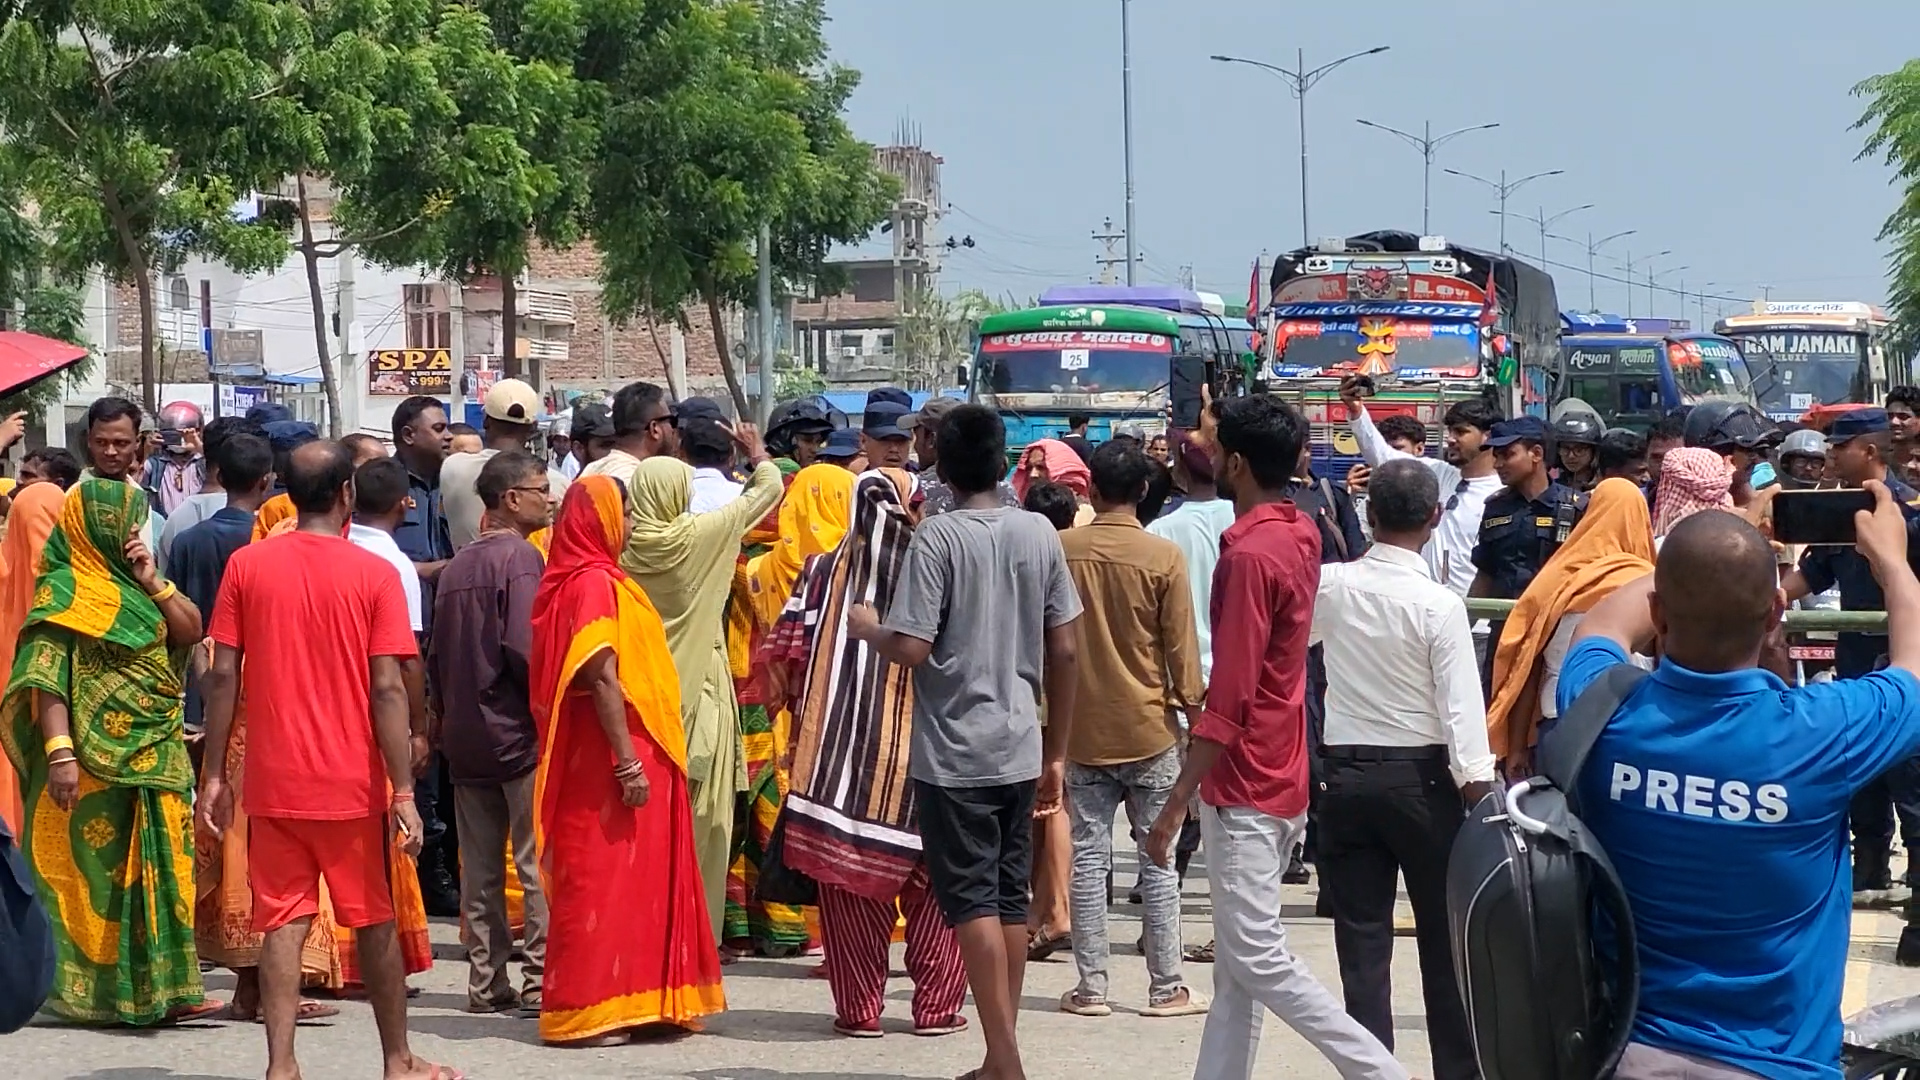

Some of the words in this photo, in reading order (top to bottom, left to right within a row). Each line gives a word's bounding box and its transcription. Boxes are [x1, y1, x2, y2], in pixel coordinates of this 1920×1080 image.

[1277, 305, 1329, 317] Visit
[1332, 304, 1400, 317] Nepal
[1745, 335, 1785, 353] RAM
[1790, 335, 1856, 354] JANAKI
[378, 351, 451, 370] SPA
[1069, 354, 1082, 366] 25
[1570, 350, 1611, 369] Aryan
[1798, 398, 1807, 407] 19
[1610, 762, 1789, 823] PRESS
